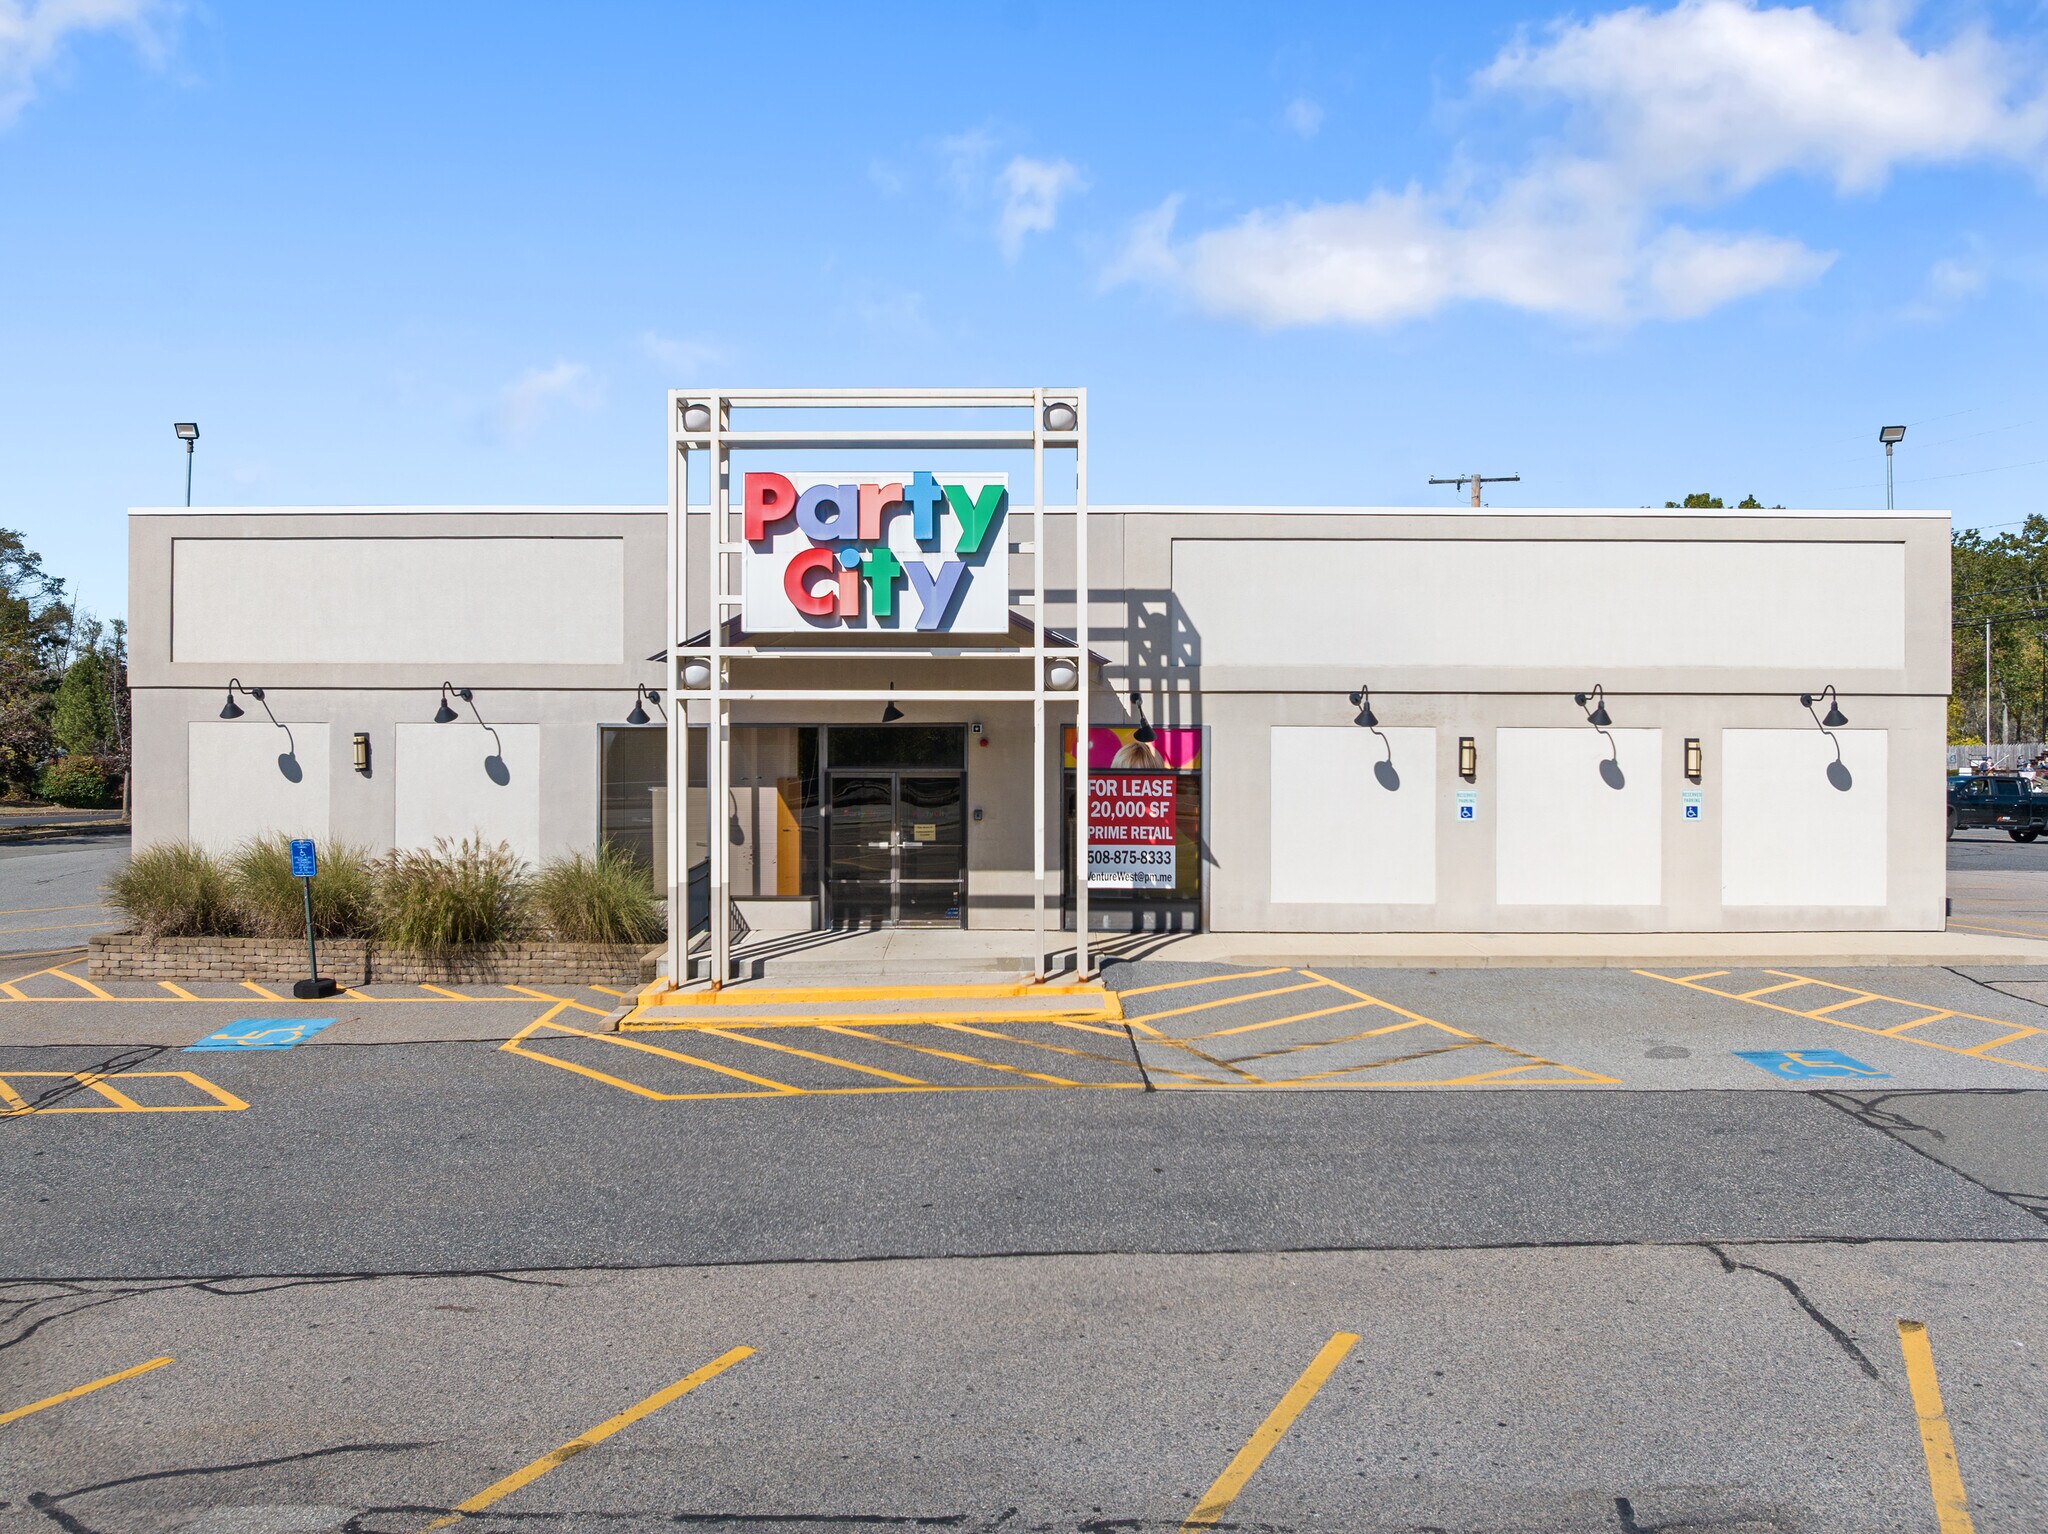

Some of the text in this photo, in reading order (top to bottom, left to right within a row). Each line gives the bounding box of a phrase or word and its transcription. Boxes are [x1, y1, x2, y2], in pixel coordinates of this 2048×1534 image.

[745, 471, 1005, 553] Party
[784, 547, 966, 630] City
[1088, 779, 1173, 797] FOR LEASE
[1090, 801, 1170, 820] 20,000 SF
[1088, 826, 1173, 840] PRIME RETAIL
[1088, 850, 1172, 864] 508-875-8333
